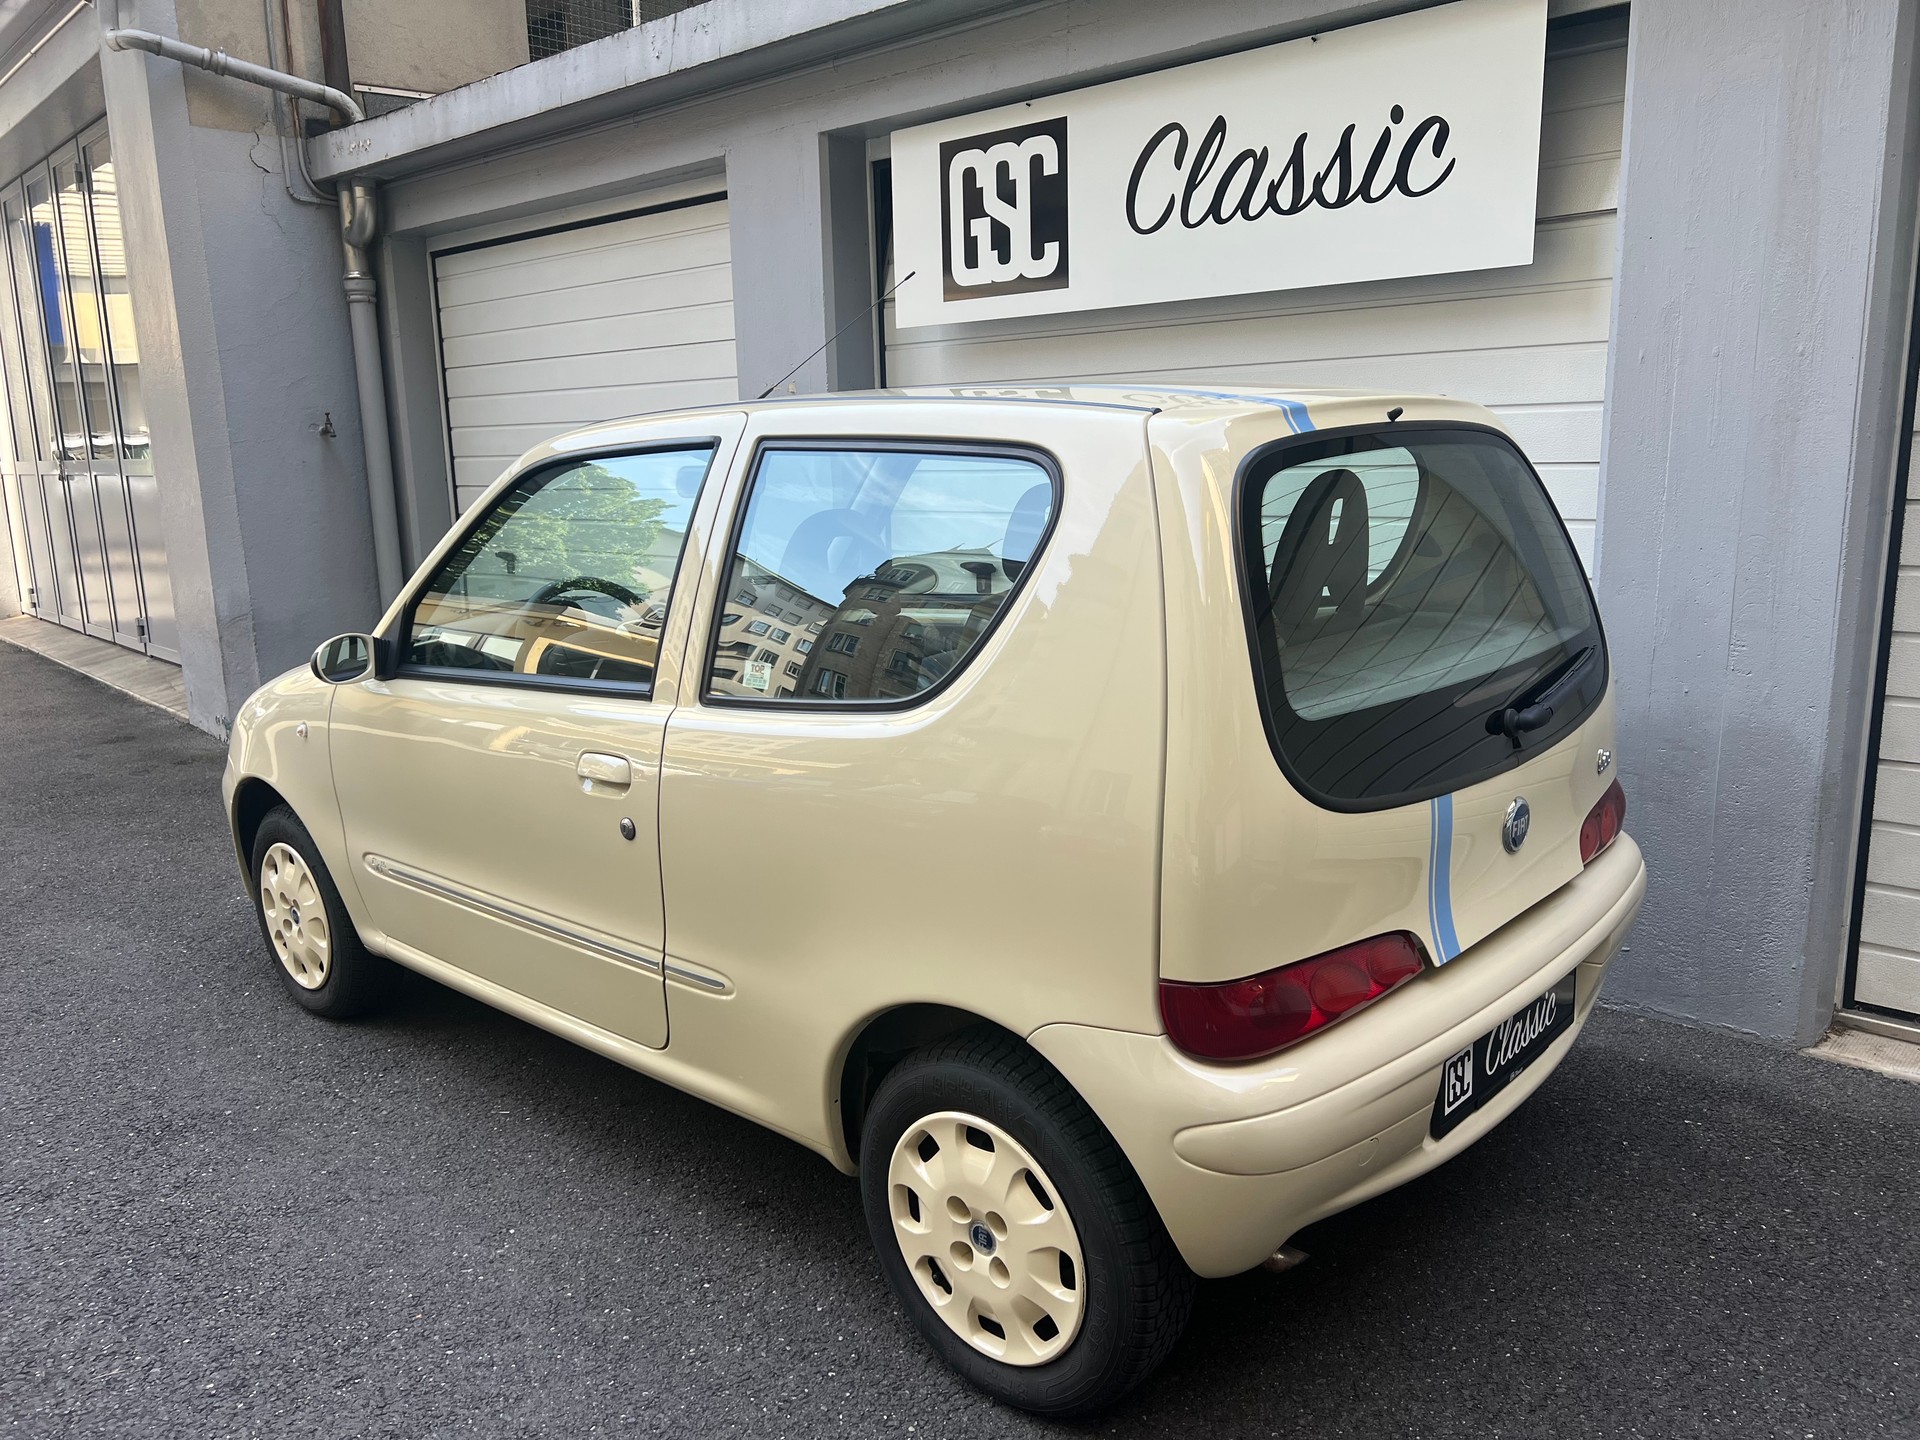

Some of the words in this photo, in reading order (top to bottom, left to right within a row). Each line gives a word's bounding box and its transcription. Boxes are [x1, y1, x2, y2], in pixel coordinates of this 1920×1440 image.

[948, 134, 1060, 287] GSC
[1125, 104, 1456, 235] Classic
[1512, 814, 1528, 838] FIAT
[1447, 1049, 1471, 1109] GSC
[1486, 992, 1557, 1076] Classic
